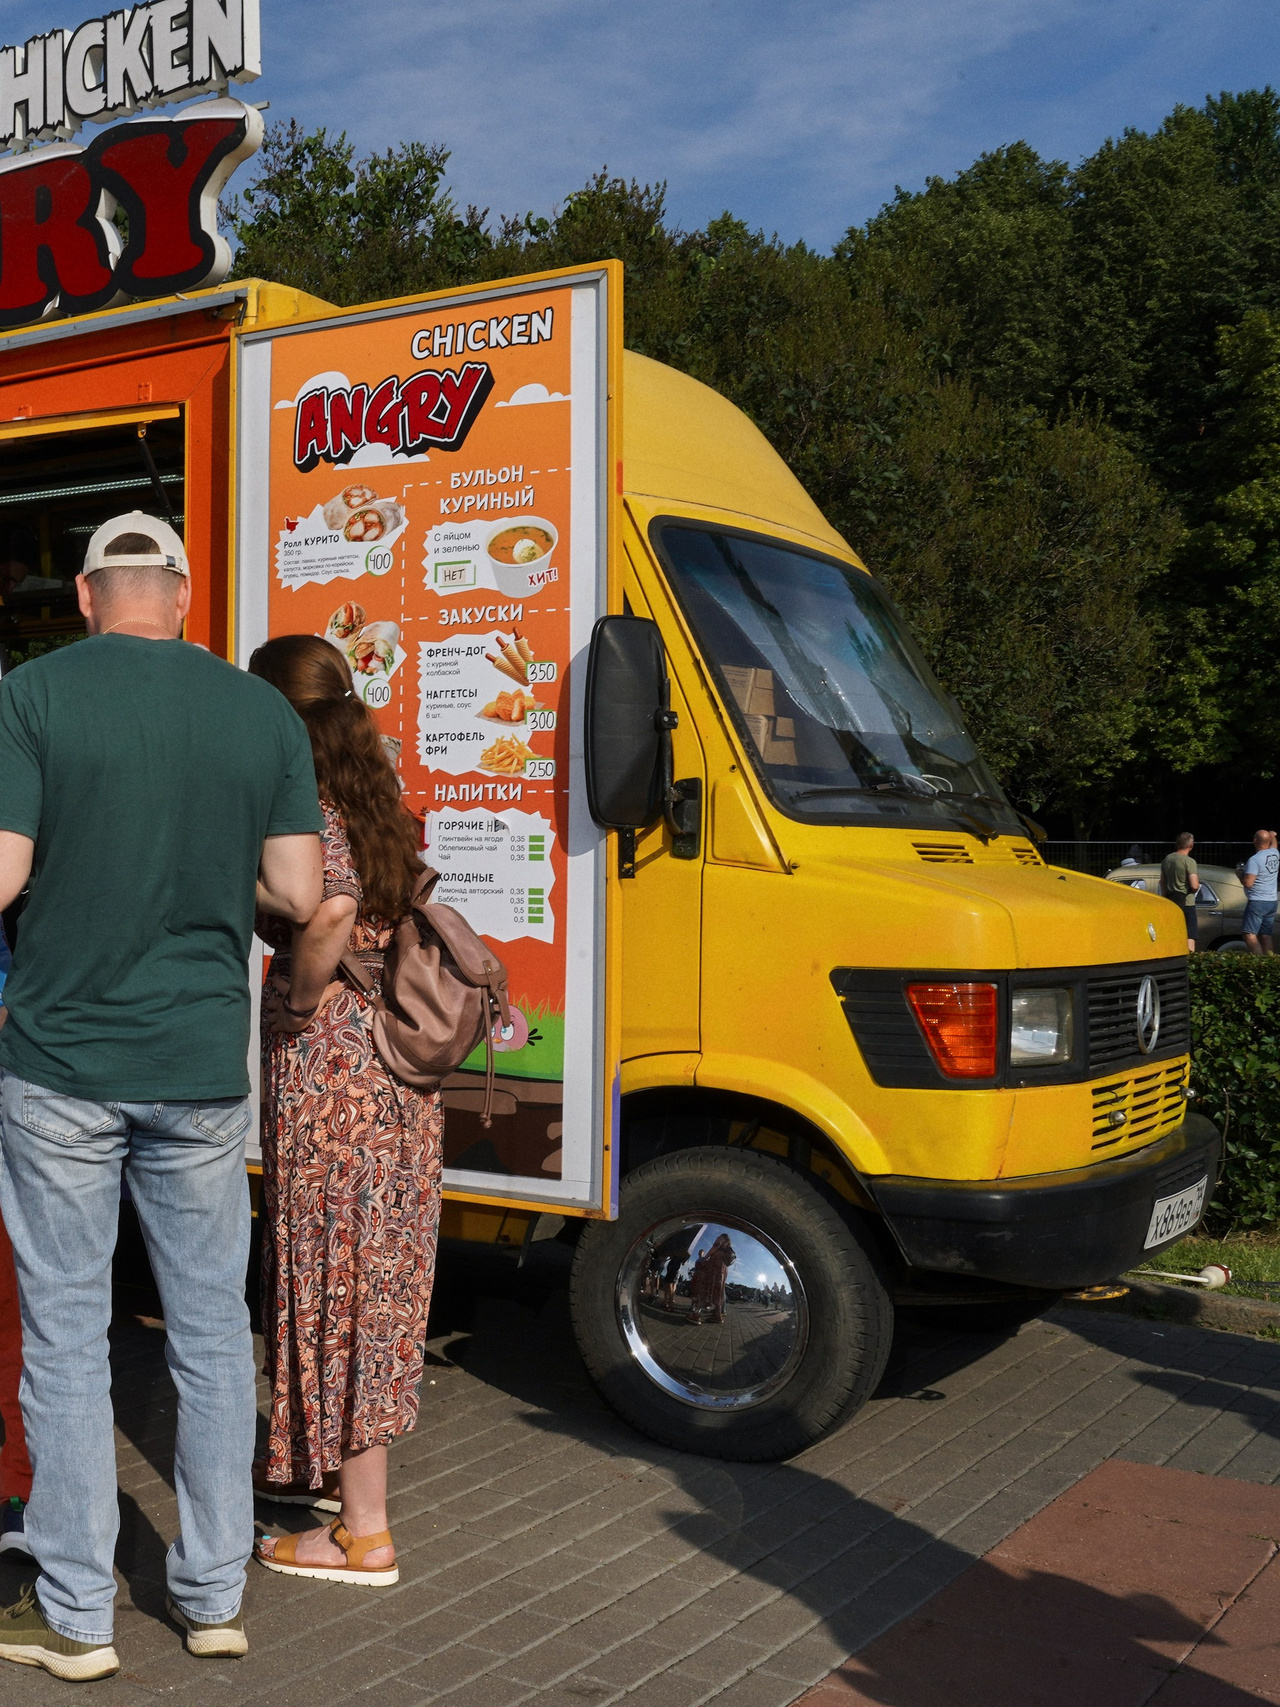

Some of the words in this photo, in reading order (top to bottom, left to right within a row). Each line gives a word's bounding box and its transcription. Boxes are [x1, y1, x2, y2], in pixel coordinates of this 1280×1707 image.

[411, 307, 554, 360] CHICKEN
[295, 363, 488, 464] ANGRY
[450, 465, 524, 489] БУЛЬОН
[440, 485, 535, 514] КУРИНЫЙ
[283, 541, 302, 549] Ролл
[304, 535, 340, 546] КУРИТО
[434, 533, 441, 541] С
[443, 532, 471, 541] яйцом
[442, 544, 480, 553] зеленью
[369, 553, 391, 570] 400
[443, 568, 466, 581] НЕТ
[528, 568, 557, 586] ХИТ!
[438, 604, 524, 626] ЗАКУСКИ
[426, 646, 486, 658] ФРЕНЧ-ДОГ
[431, 660, 458, 669] куриной
[529, 663, 555, 681] 350
[367, 686, 390, 703] 400
[426, 689, 478, 699] НАГГЕТСЫ
[530, 711, 555, 729] 300
[425, 732, 485, 742] КАРТОФЕЛЬ
[425, 746, 447, 755] ФРИ
[528, 761, 554, 778] 250
[434, 783, 522, 802] НАПИТКИ
[438, 821, 484, 830] ГОРЯЧИЕ
[438, 886, 468, 894] Лимонад
